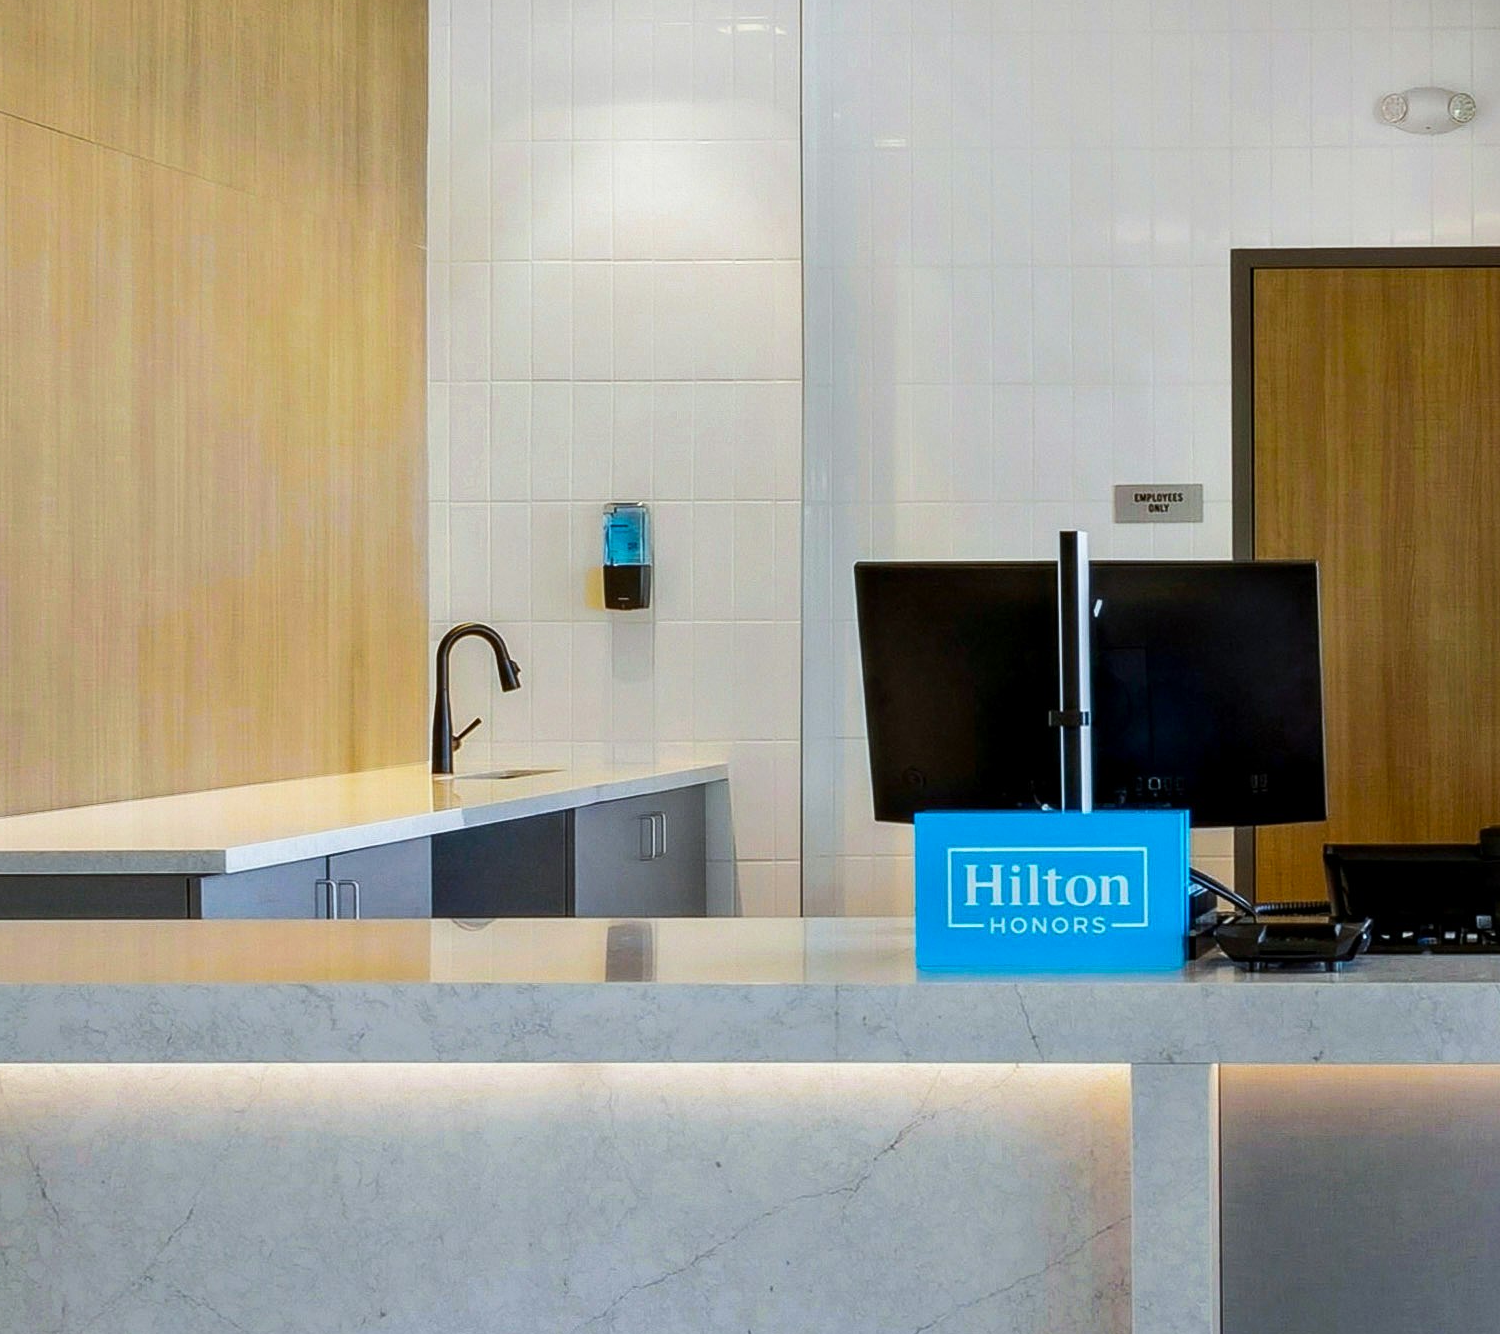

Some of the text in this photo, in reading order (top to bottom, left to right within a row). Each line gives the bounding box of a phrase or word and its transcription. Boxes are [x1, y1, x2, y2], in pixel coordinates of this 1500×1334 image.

[1134, 493, 1184, 503] EMPLOYEES
[1148, 503, 1170, 513] ONLY
[964, 864, 1131, 907] Hilton
[989, 917, 1107, 935] HONORS
